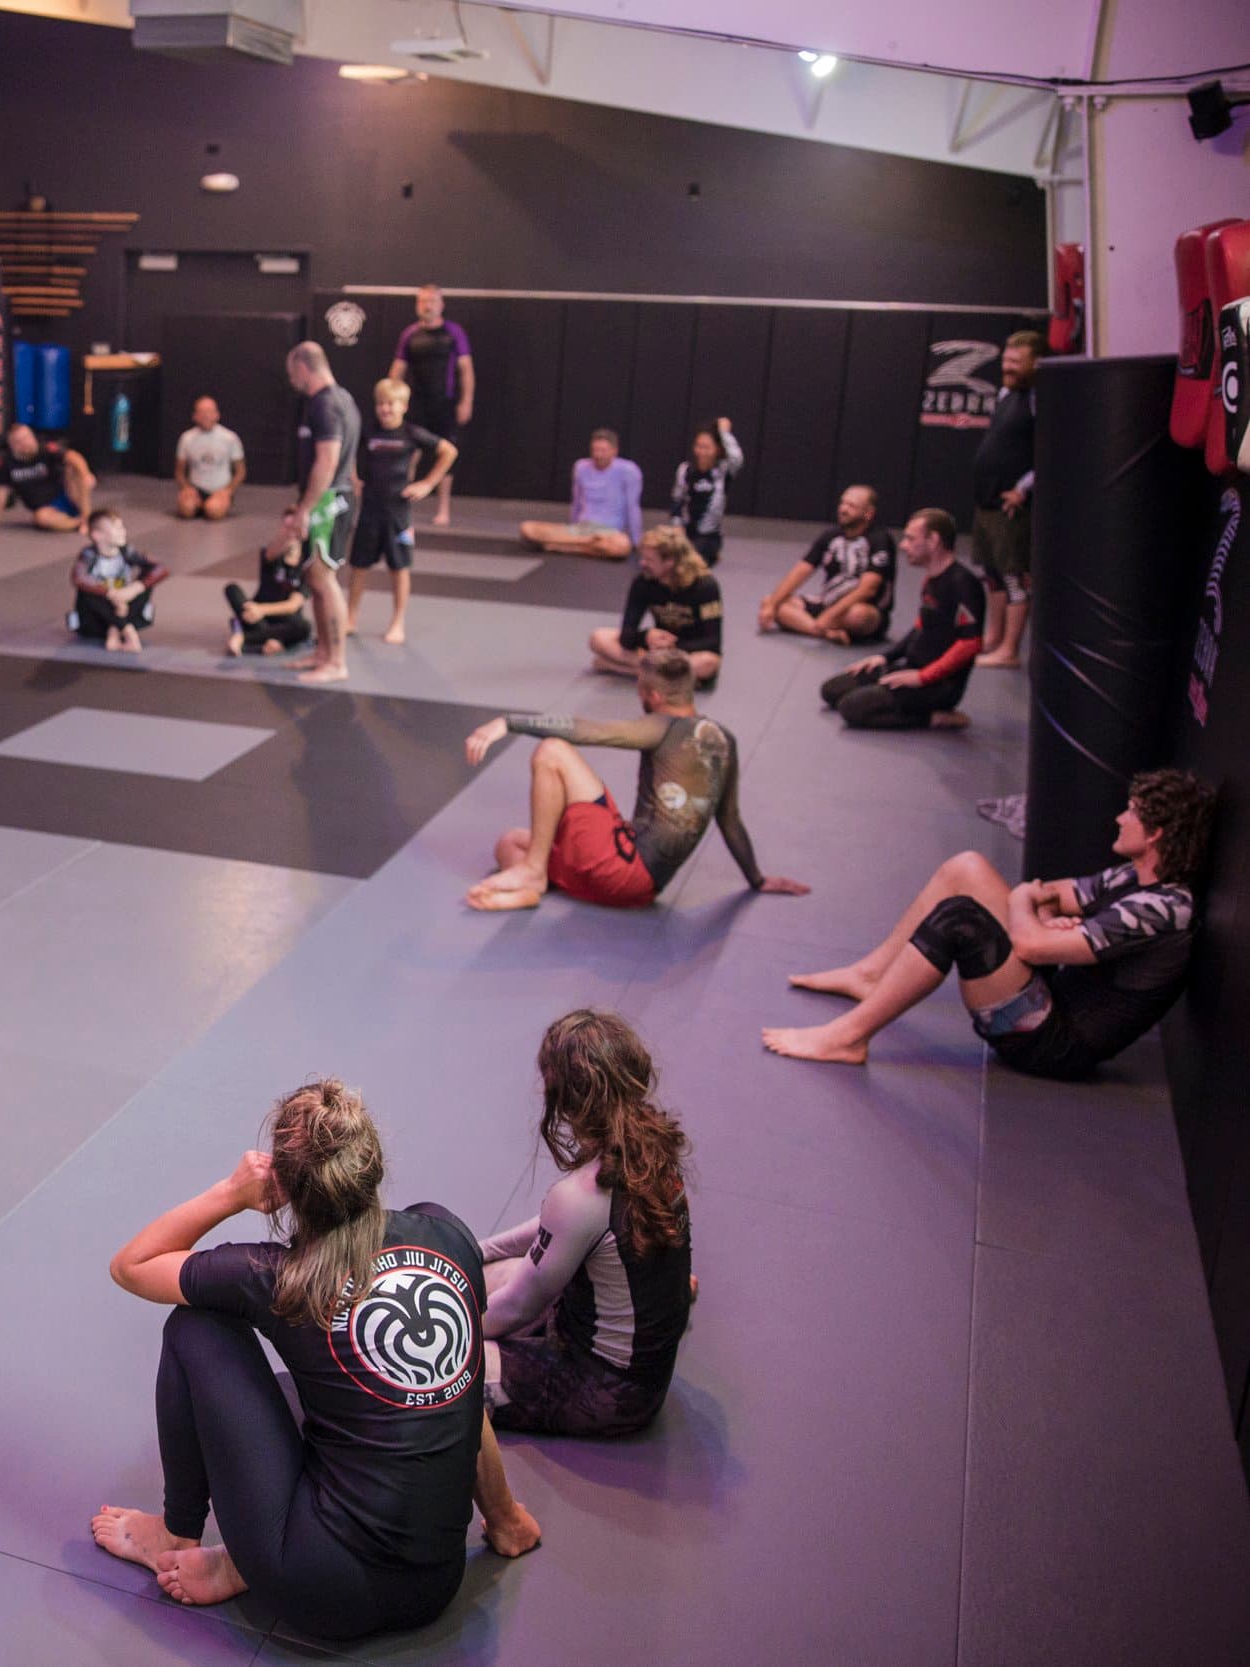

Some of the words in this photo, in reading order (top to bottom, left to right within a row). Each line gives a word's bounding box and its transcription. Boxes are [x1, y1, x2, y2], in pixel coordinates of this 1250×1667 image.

[403, 1250, 425, 1267] JIU
[429, 1257, 468, 1293] JITSU
[405, 1392, 439, 1406] EST.
[443, 1370, 472, 1400] 2009
